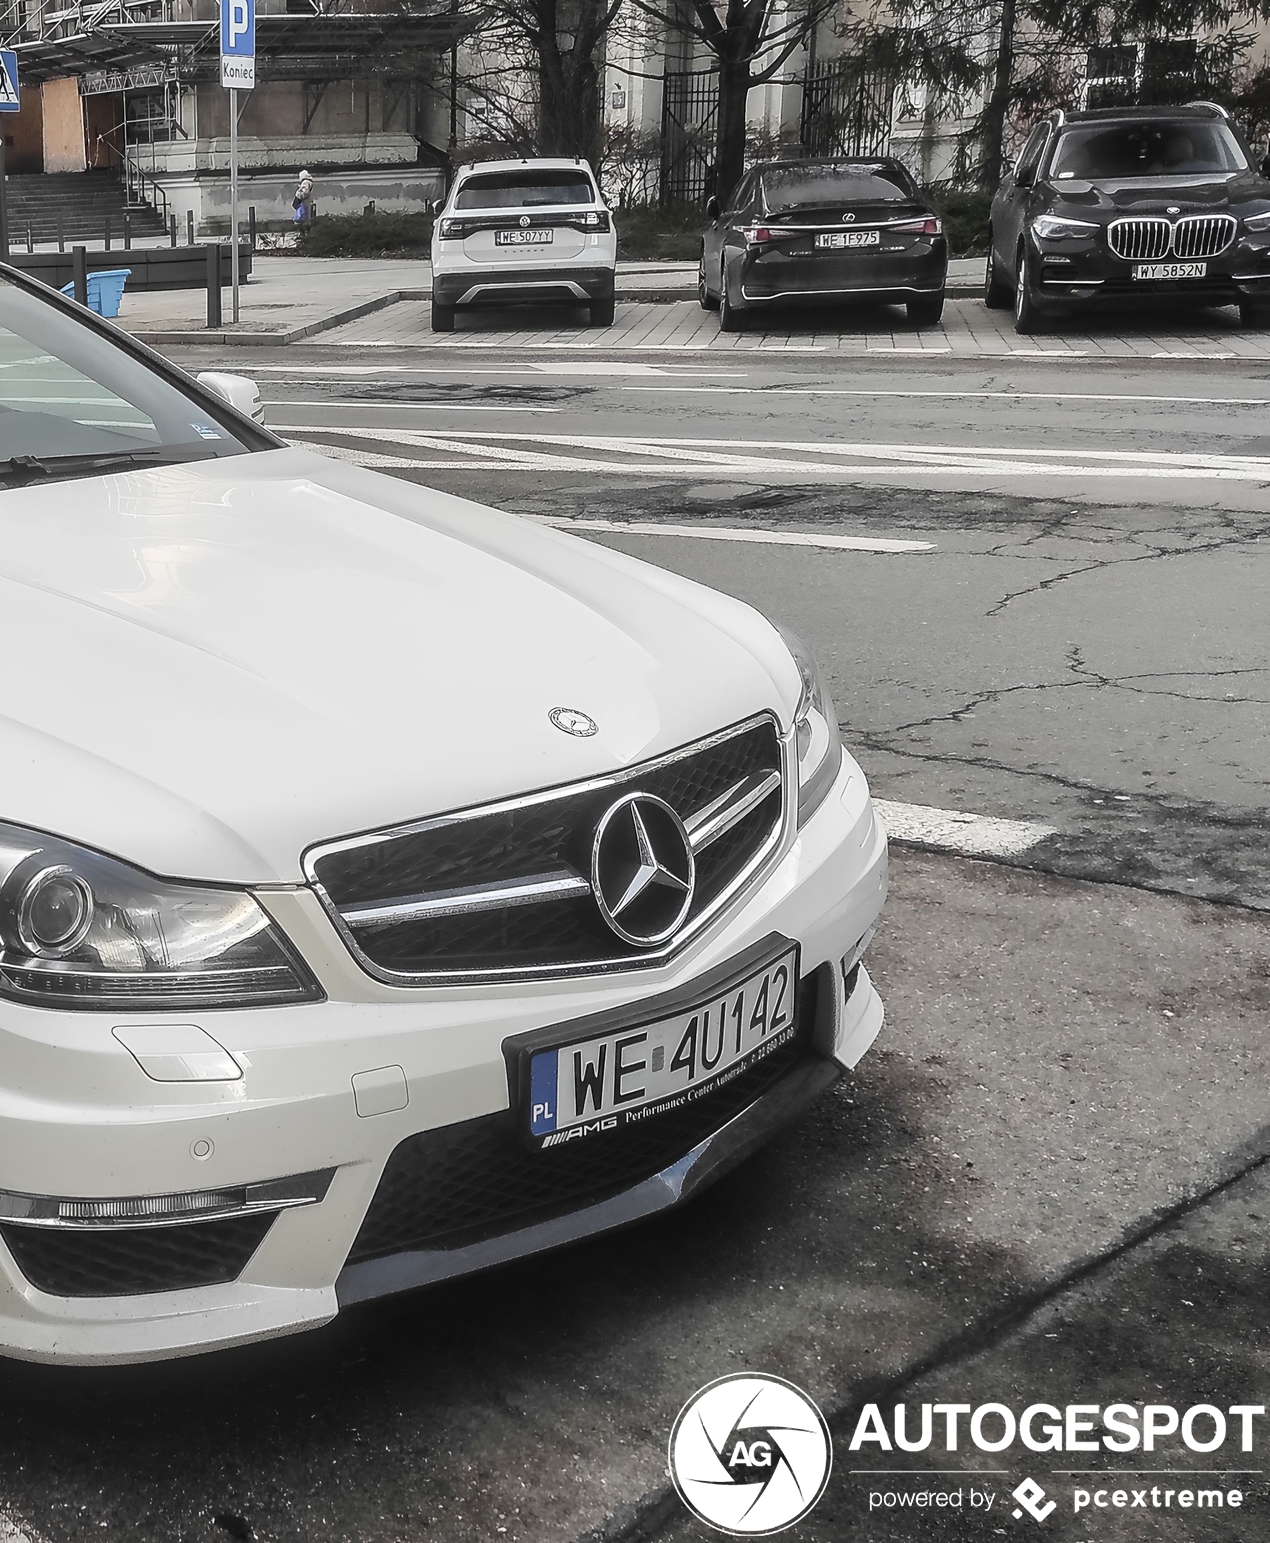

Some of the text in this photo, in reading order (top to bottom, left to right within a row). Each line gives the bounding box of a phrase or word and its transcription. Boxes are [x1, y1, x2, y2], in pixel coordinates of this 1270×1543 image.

[229, 0, 249, 48] P
[223, 62, 253, 80] Koniec
[502, 232, 516, 243] WE
[822, 232, 877, 246] WE 1F975
[1140, 263, 1203, 278] WY 5852N
[572, 963, 789, 1118] WE 4U142
[625, 1095, 686, 1123] Performance
[687, 1081, 714, 1102] Center
[532, 1101, 554, 1124] PL
